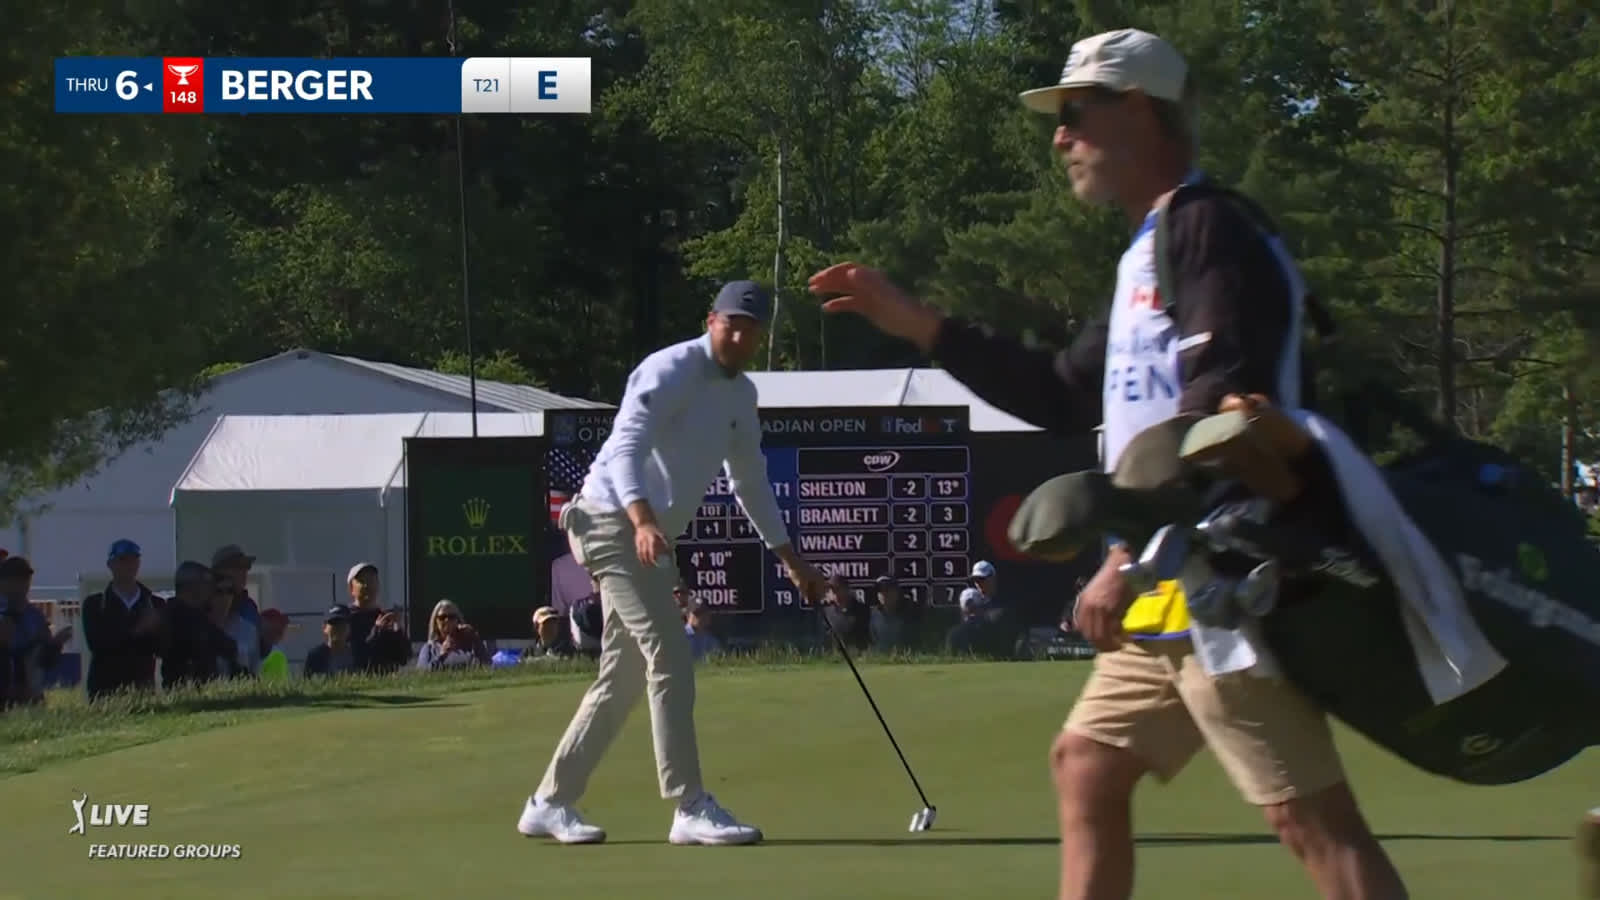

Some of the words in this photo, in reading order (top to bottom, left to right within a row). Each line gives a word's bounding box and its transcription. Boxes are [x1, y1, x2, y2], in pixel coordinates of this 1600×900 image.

[578, 415, 615, 425] CANAD
[762, 419, 815, 433] ADIAN
[819, 419, 866, 433] OPEN
[895, 418, 935, 433] Fed
[578, 426, 607, 441] OP
[774, 482, 790, 497] T1
[801, 481, 866, 497] SHELTON
[902, 481, 917, 495] -2
[801, 507, 879, 523] BRAMLETT
[903, 508, 917, 522] -2
[944, 507, 953, 522] 3
[426, 535, 528, 556] ROLEX
[801, 535, 863, 550] WHALEY
[904, 534, 918, 549] -2
[810, 561, 869, 578] SMITH
[904, 561, 918, 576] -1
[944, 560, 954, 576] 9
[697, 569, 727, 586] FOR
[775, 590, 793, 605] T9
[904, 588, 918, 602] -1
[946, 587, 954, 602] 7
